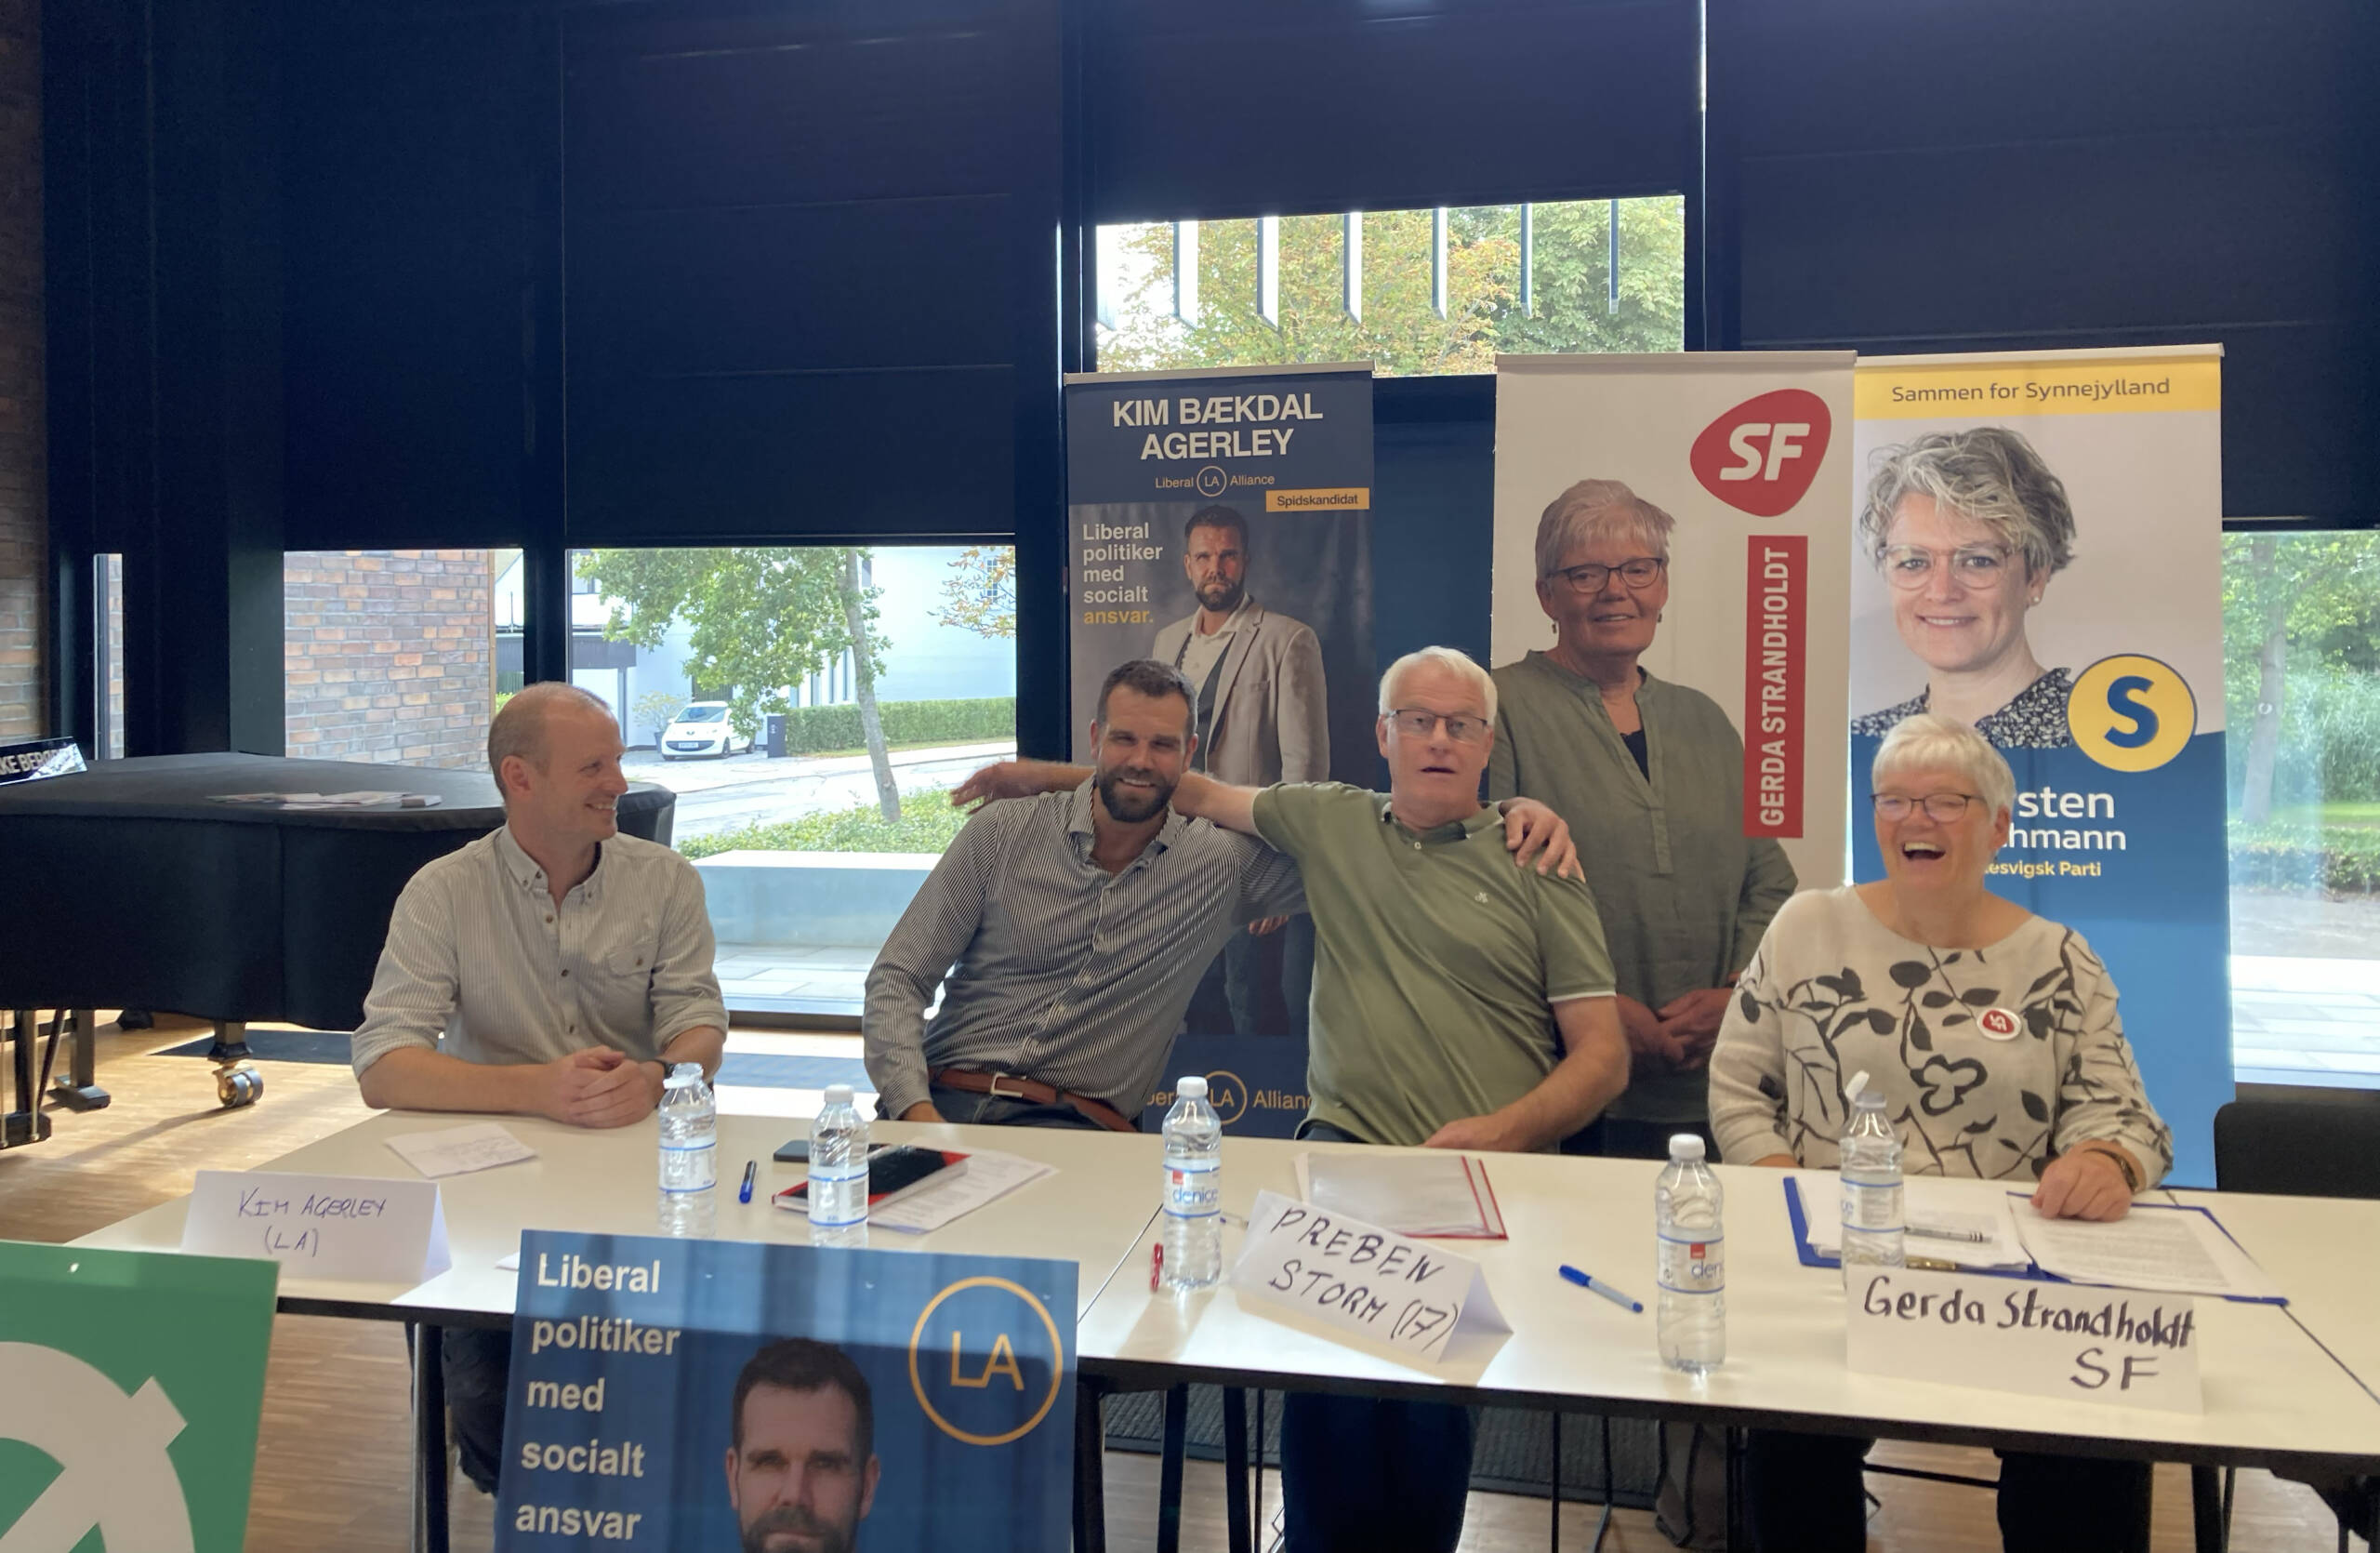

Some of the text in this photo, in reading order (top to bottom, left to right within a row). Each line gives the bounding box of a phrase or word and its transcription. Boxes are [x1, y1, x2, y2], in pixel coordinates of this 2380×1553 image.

[1892, 378, 2170, 402] Sammen for Synnejylland
[1113, 392, 1324, 427] KIM BÆKDAL
[1140, 429, 1295, 460] AGERLEY
[1719, 422, 1810, 481] SF
[1155, 474, 1276, 489] Liberal LA Alliance
[1276, 493, 1358, 509] Spidskandidat
[1082, 522, 1149, 541] Liberal
[1082, 544, 1163, 565] politiker
[1083, 564, 1124, 583] med
[1083, 586, 1148, 604] socialt
[1083, 608, 1154, 624] ansvar.
[1760, 547, 1790, 826] GERDA STRANDHOLDT
[2104, 675, 2160, 749] S
[2002, 822, 2127, 850] hmann
[1985, 860, 2102, 879] esvigsk Parti
[1252, 1089, 1313, 1109] Allian
[238, 1187, 387, 1219] KIM AGERLEY
[1271, 1207, 1446, 1283] PREBEN
[537, 1253, 660, 1294] Liberal
[1268, 1259, 1389, 1323] STORM
[1863, 1275, 2195, 1349] Gerda Strandholdt
[531, 1315, 681, 1356] politiker
[950, 1330, 1025, 1391] LA
[2069, 1347, 2160, 1391] SF
[527, 1377, 605, 1413] med
[521, 1439, 645, 1478] socialt
[515, 1503, 642, 1541] ansvar
